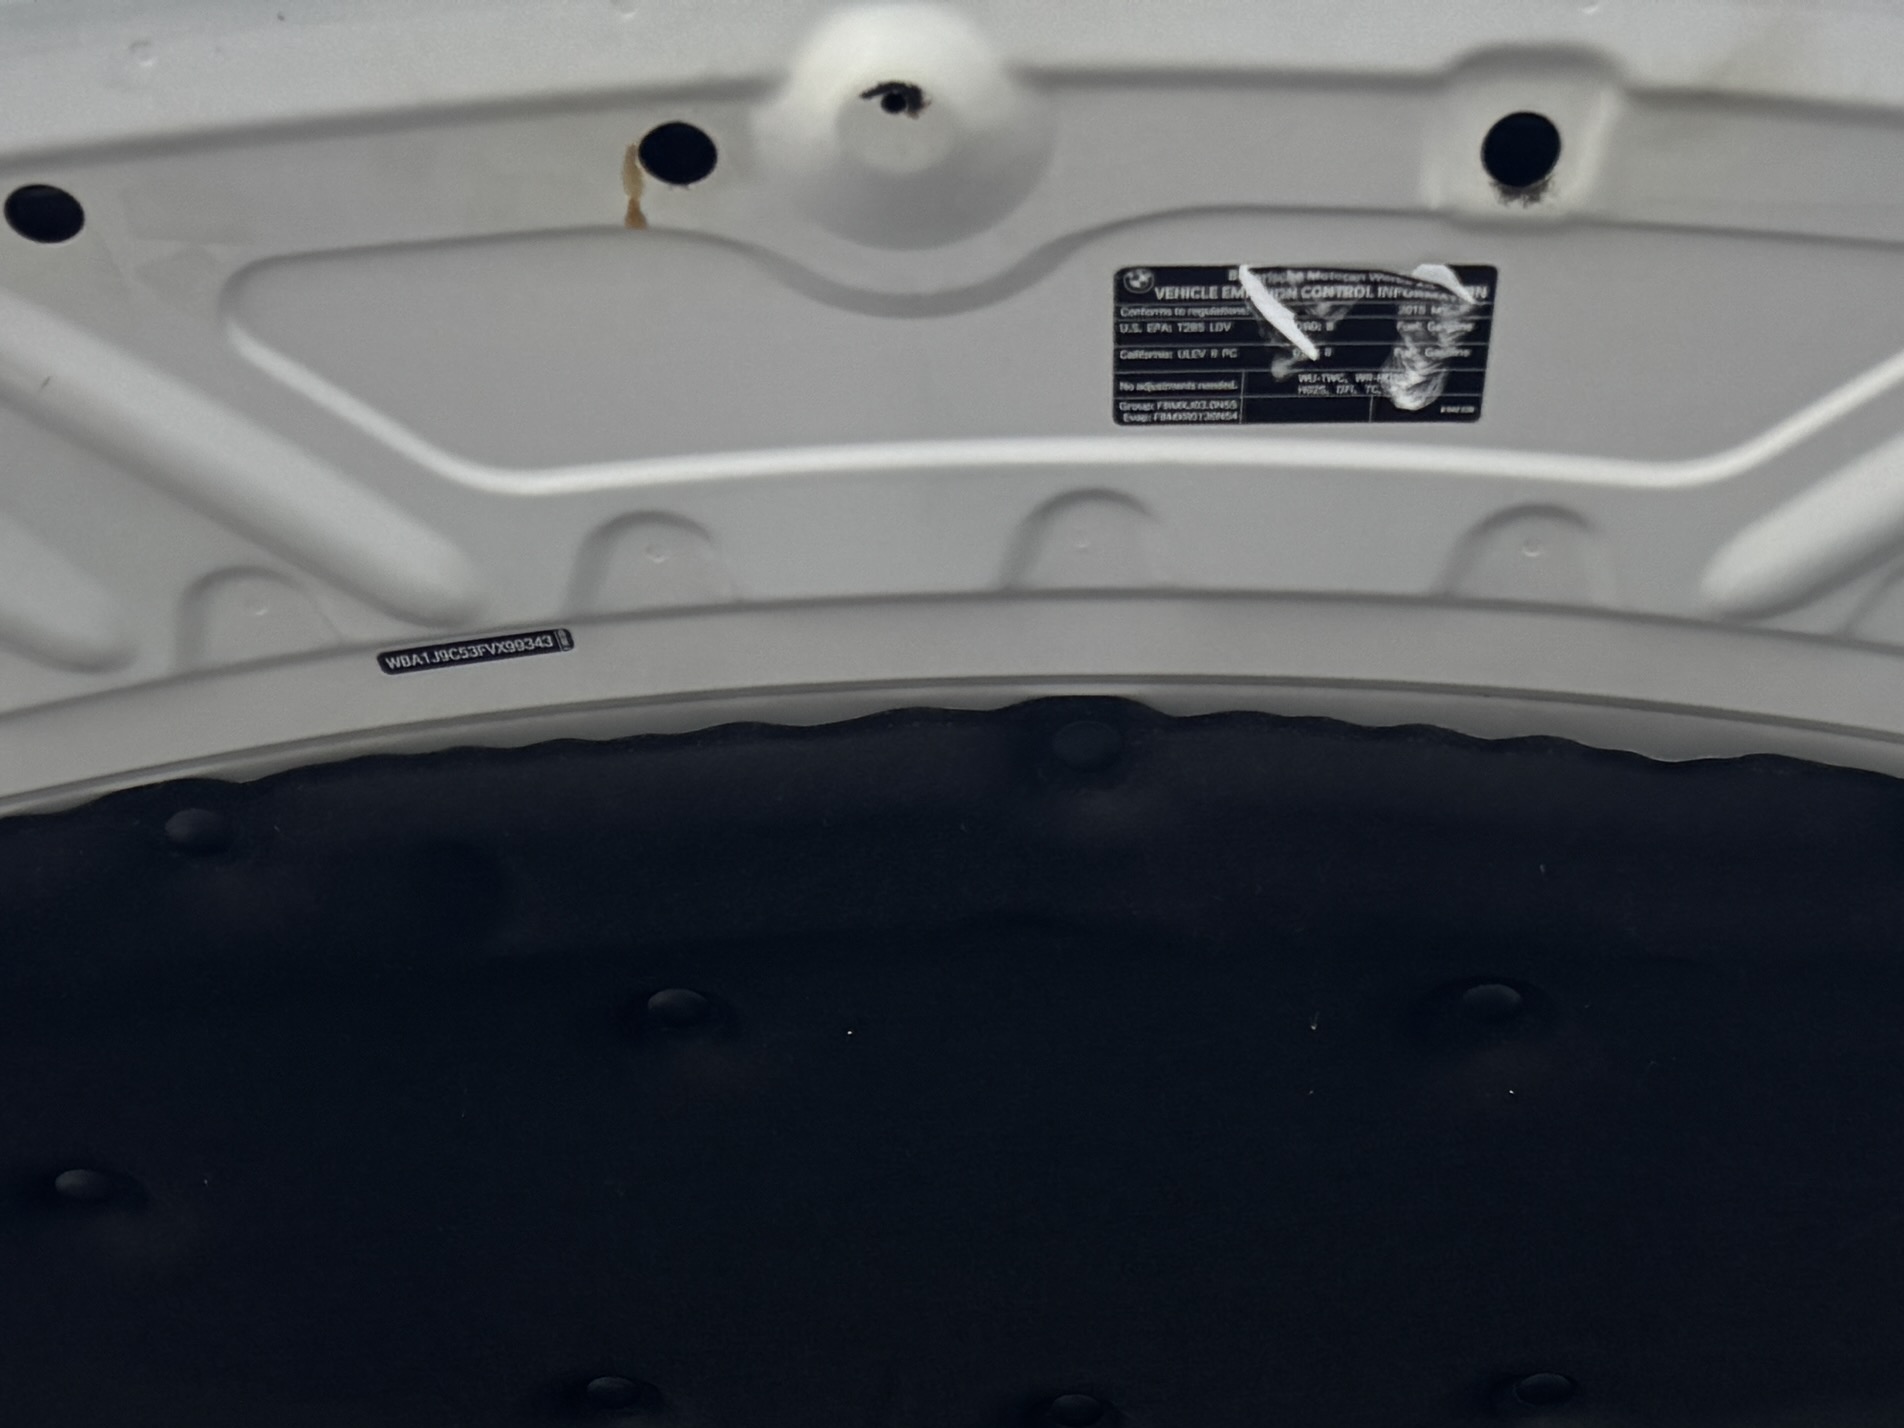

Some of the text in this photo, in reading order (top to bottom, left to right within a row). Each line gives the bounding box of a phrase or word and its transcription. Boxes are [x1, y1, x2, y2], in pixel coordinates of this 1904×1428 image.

[1154, 286, 1218, 300] VEHICLE
[1301, 286, 1373, 299] CONTROL
[1119, 323, 1143, 334] U.S.
[1119, 382, 1134, 391] No
[385, 634, 554, 670] WBA1J9C53FVX99343
